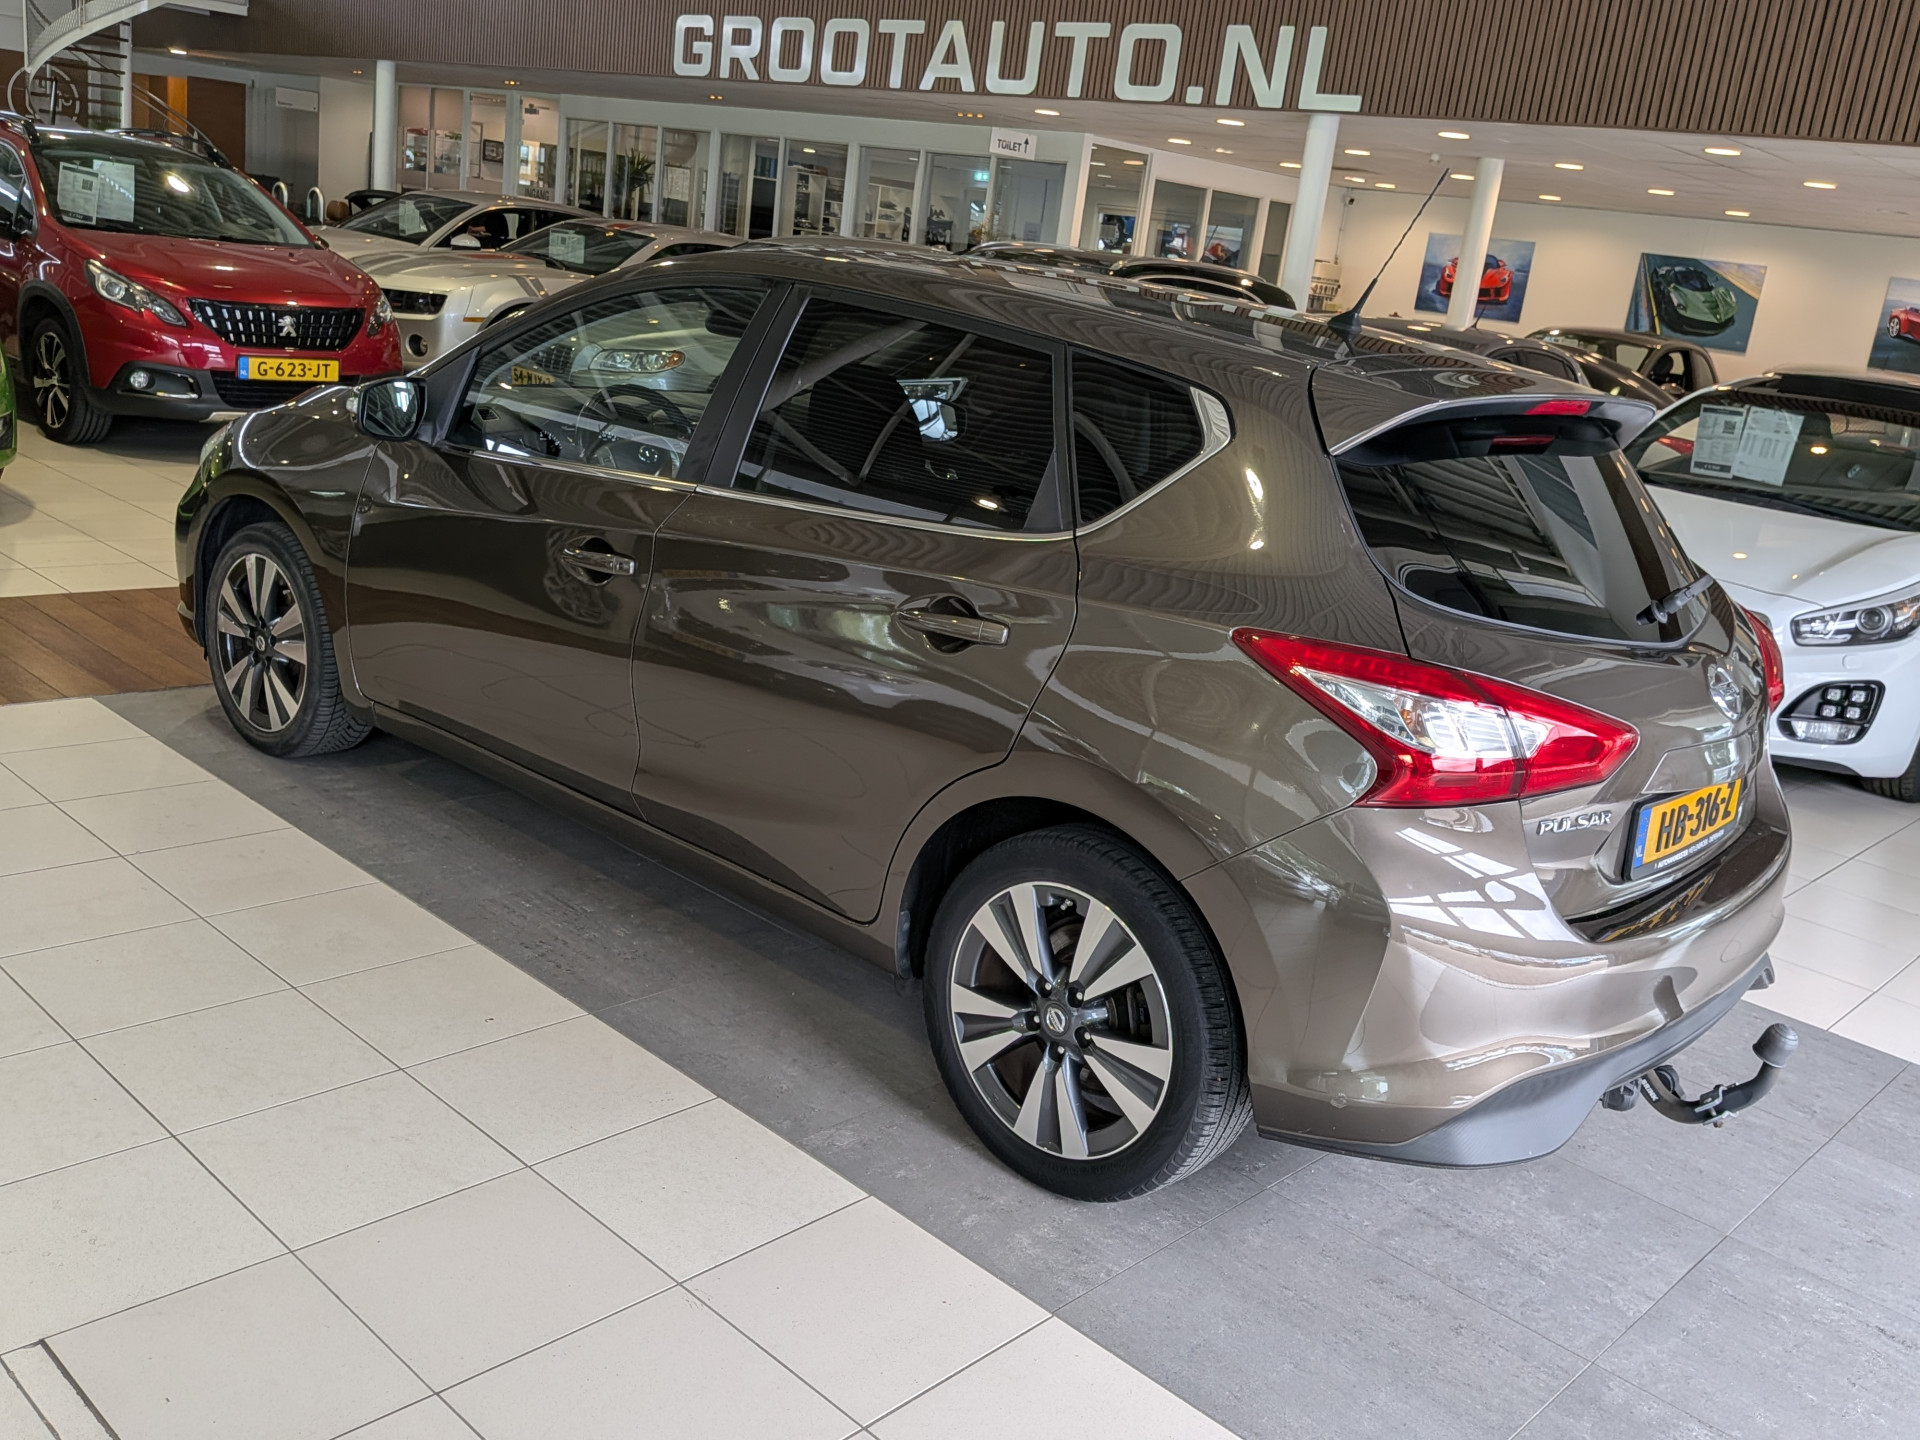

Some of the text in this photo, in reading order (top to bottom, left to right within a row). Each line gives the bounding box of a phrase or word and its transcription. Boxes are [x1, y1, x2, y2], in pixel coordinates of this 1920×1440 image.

[673, 14, 1362, 112] GROOTAUTO.NL
[997, 138, 1022, 152] TOILET
[257, 361, 331, 378] G-623-JT
[1537, 811, 1612, 835] PULSAR
[1655, 780, 1736, 853] HB-316-Z
